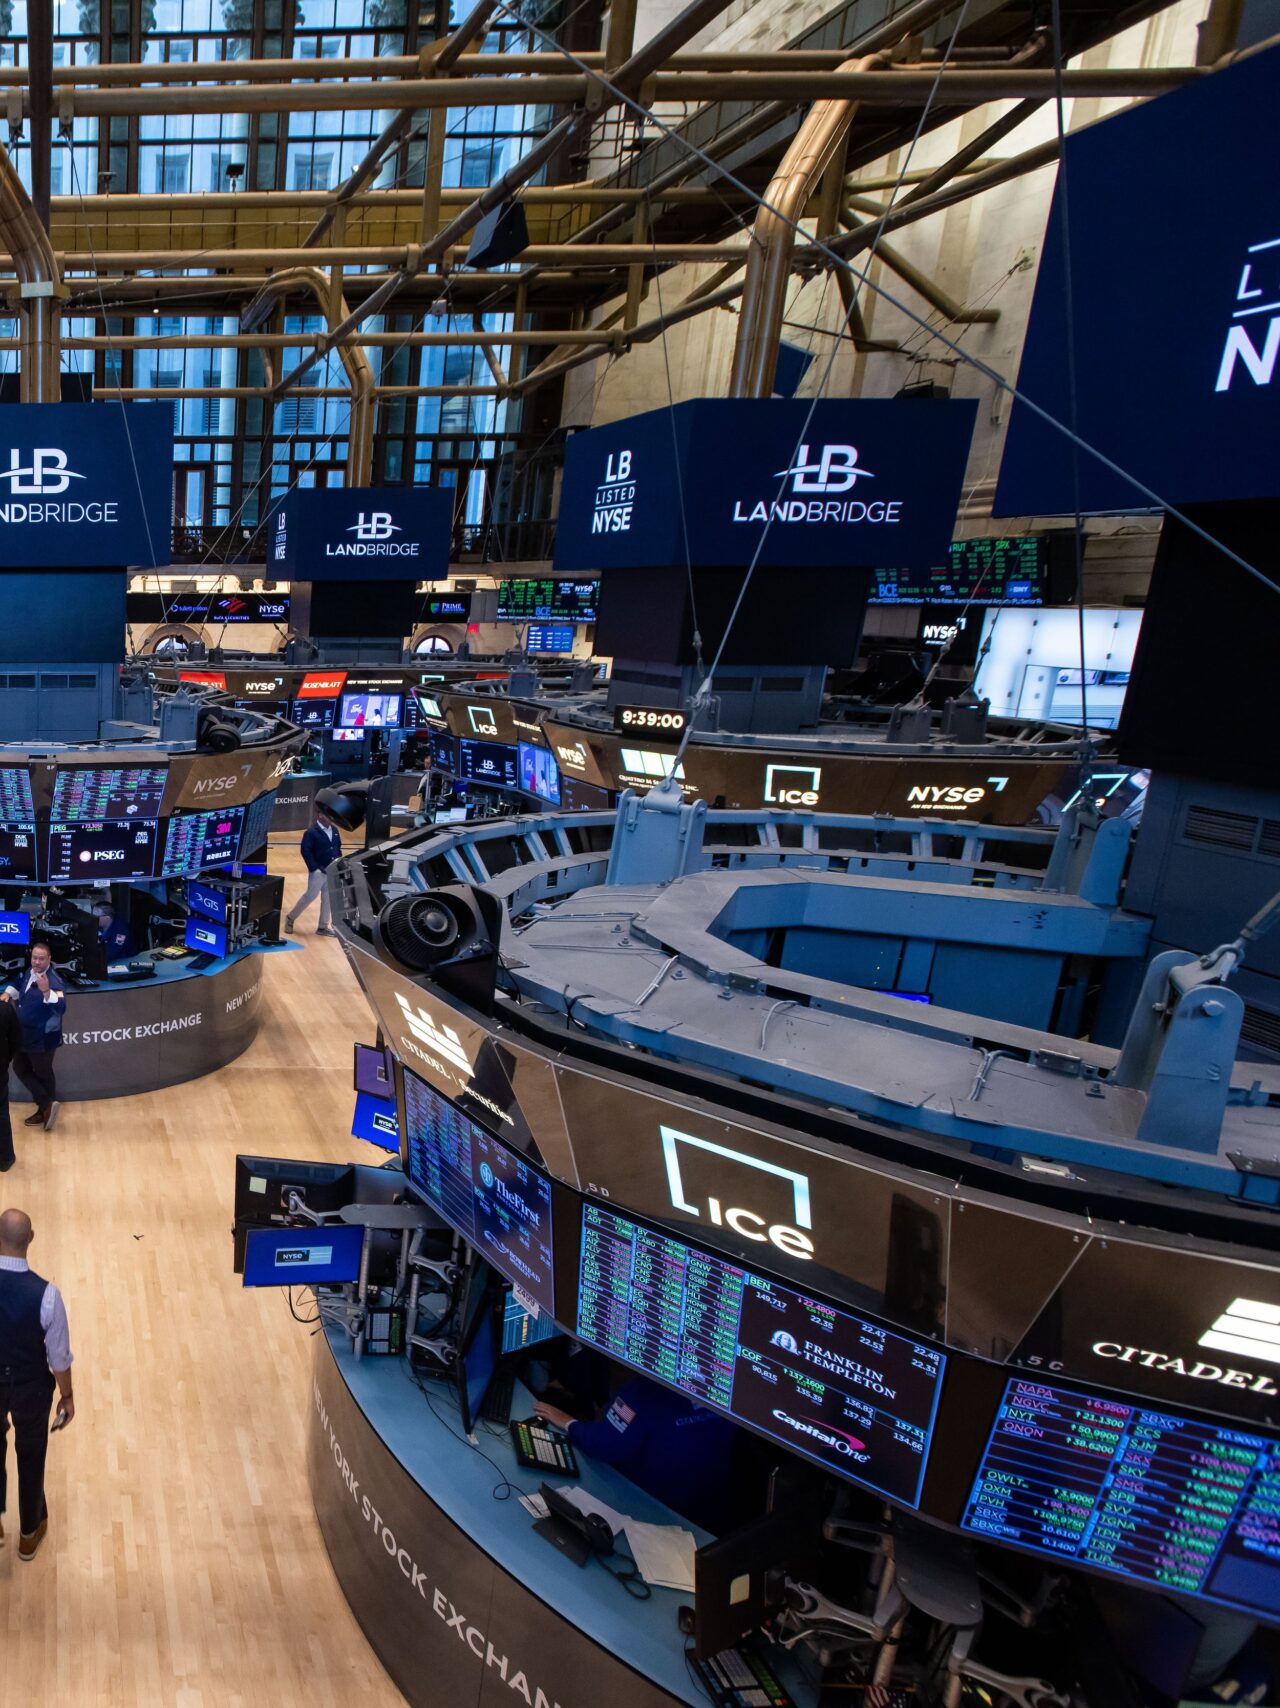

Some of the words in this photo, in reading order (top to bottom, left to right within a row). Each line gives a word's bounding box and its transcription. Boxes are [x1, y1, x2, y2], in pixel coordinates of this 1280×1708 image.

[11, 448, 70, 494] LB
[606, 450, 632, 483] LB
[792, 445, 858, 492] LB
[595, 486, 636, 505] LISTED
[733, 501, 904, 522] LANDBRIDGE
[357, 512, 393, 540] LB
[592, 507, 633, 534] NYSE
[326, 543, 420, 556] LANDBRIDGE
[878, 584, 898, 597] BCE
[535, 606, 551, 616] BCE
[245, 682, 276, 691] NYSE
[303, 681, 342, 689] ROSENBLATT
[622, 710, 684, 729] 9:39:00
[275, 796, 309, 804] EXCHANGE
[216, 822, 231, 834] 3M
[94, 850, 125, 861] PSEG
[225, 995, 243, 1013] NEW
[135, 1012, 202, 1038] EXCHANGE
[61, 1032, 79, 1045] RK
[82, 1027, 132, 1044] STOCK
[401, 1036, 451, 1080] CITADEL
[458, 1078, 514, 1127] Securities
[589, 1182, 598, 1194] 5
[691, 1260, 711, 1272] GNW
[749, 1276, 770, 1291] BEN
[810, 1315, 833, 1330] 22.35
[741, 1348, 762, 1362] COF
[804, 1340, 884, 1382] FRANKLIN
[1027, 1356, 1043, 1365] 5
[1049, 1361, 1064, 1371] C
[1092, 1341, 1278, 1395] CITADEL
[803, 1350, 897, 1400] TEMPLETON
[1017, 1383, 1053, 1399] NAPA
[1012, 1396, 1050, 1411] NGVC
[1008, 1408, 1035, 1422] NYT
[1083, 1413, 1124, 1429] 21.1300
[1004, 1422, 1044, 1438] ONON
[1073, 1438, 1114, 1454] 38.6200
[983, 1483, 1012, 1496] OXM
[980, 1495, 1005, 1507] PVH
[329, 1423, 360, 1502] YORK
[361, 1495, 428, 1599] STOCK
[433, 1587, 562, 1708] EXCHAN
